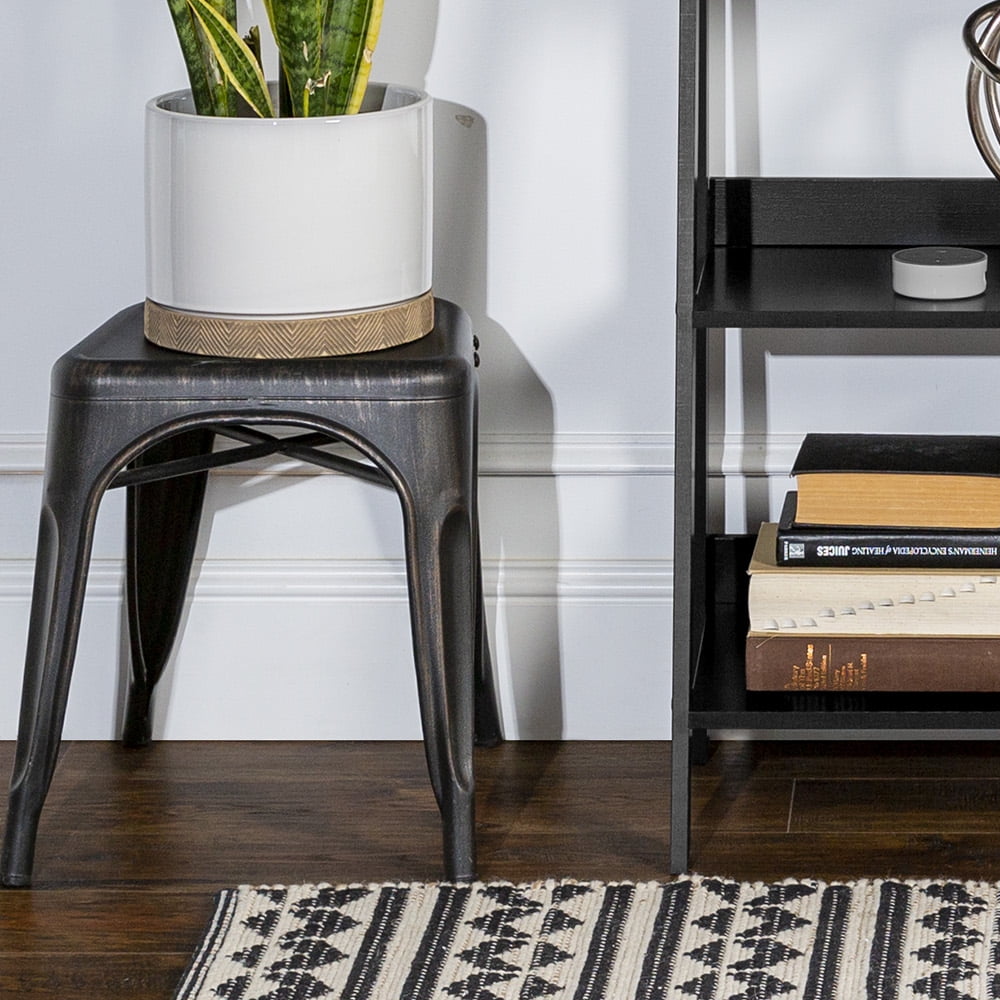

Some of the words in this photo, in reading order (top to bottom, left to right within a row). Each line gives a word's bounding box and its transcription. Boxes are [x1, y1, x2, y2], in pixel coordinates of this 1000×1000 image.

[816, 545, 850, 557] JUICES
[851, 546, 885, 556] HEALING
[884, 544, 893, 556] of
[892, 546, 947, 556] ENCYCLOPEDIA
[947, 546, 998, 556] HEINERMAN'S
